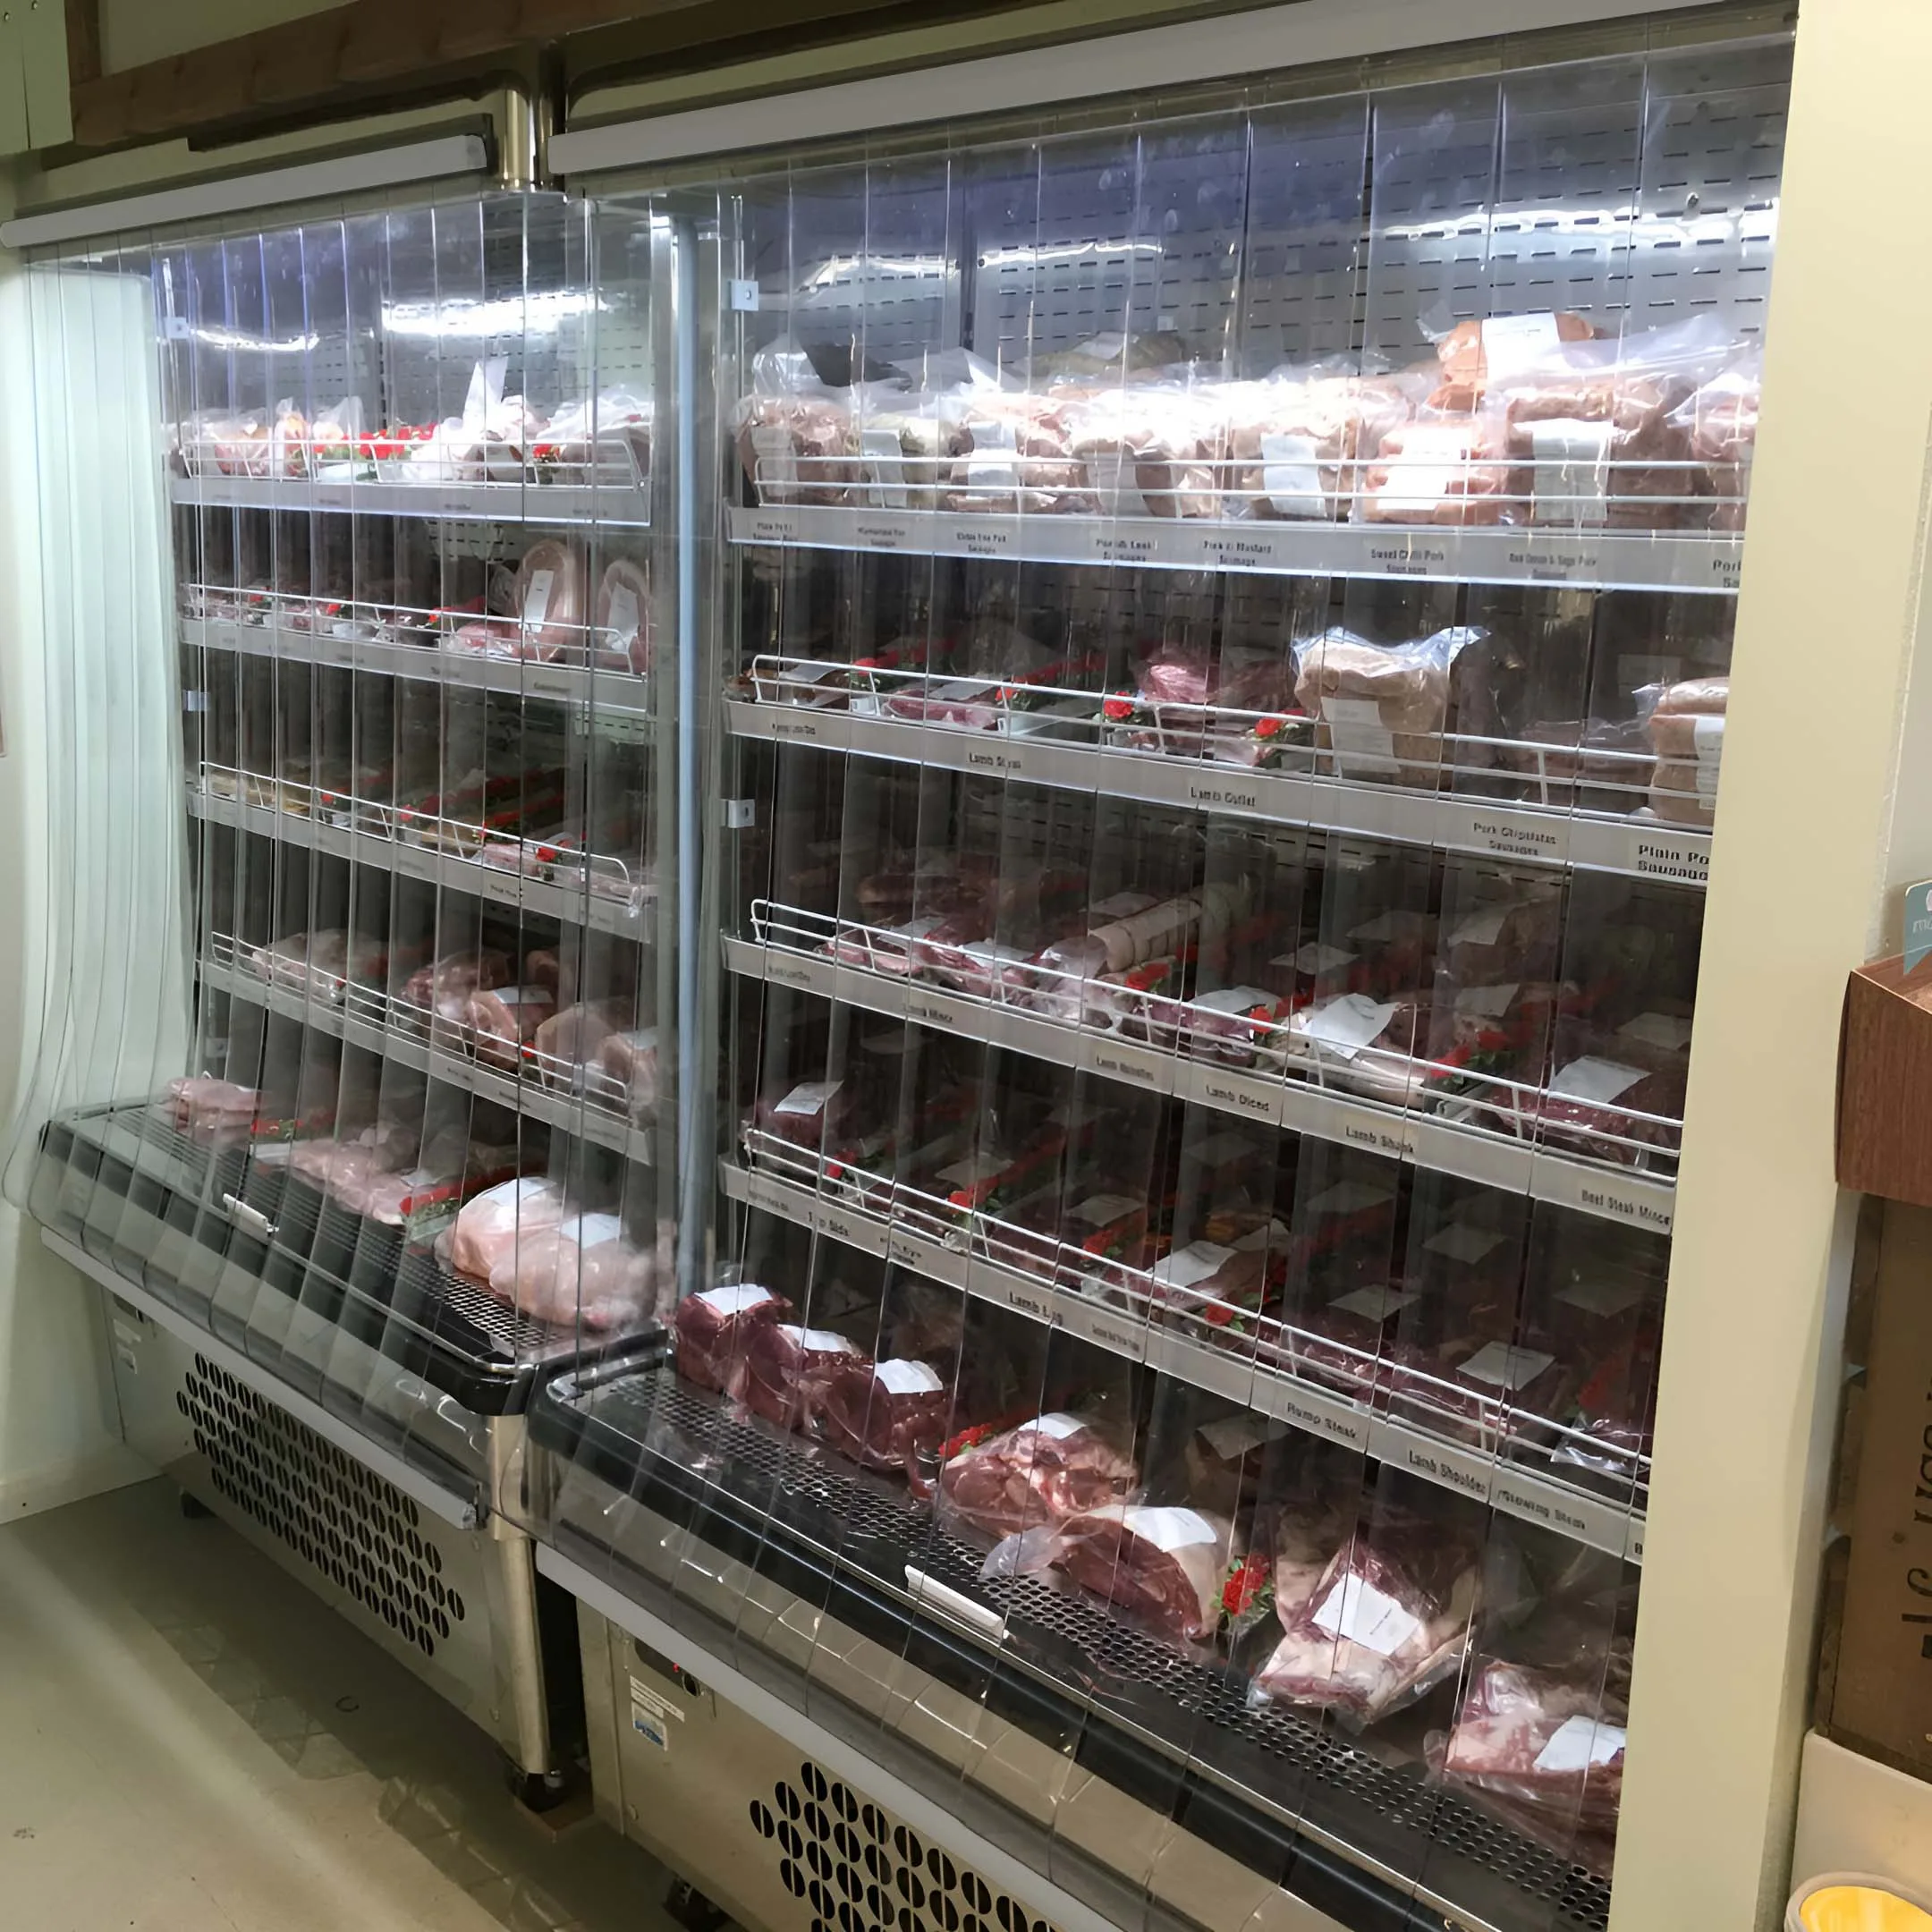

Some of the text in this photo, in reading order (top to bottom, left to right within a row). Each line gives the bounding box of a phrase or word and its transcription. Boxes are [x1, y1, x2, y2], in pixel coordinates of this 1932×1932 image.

[1639, 845, 1680, 860] Plain
[1206, 1085, 1235, 1101] Lamb
[1346, 1126, 1377, 1144] Lamb
